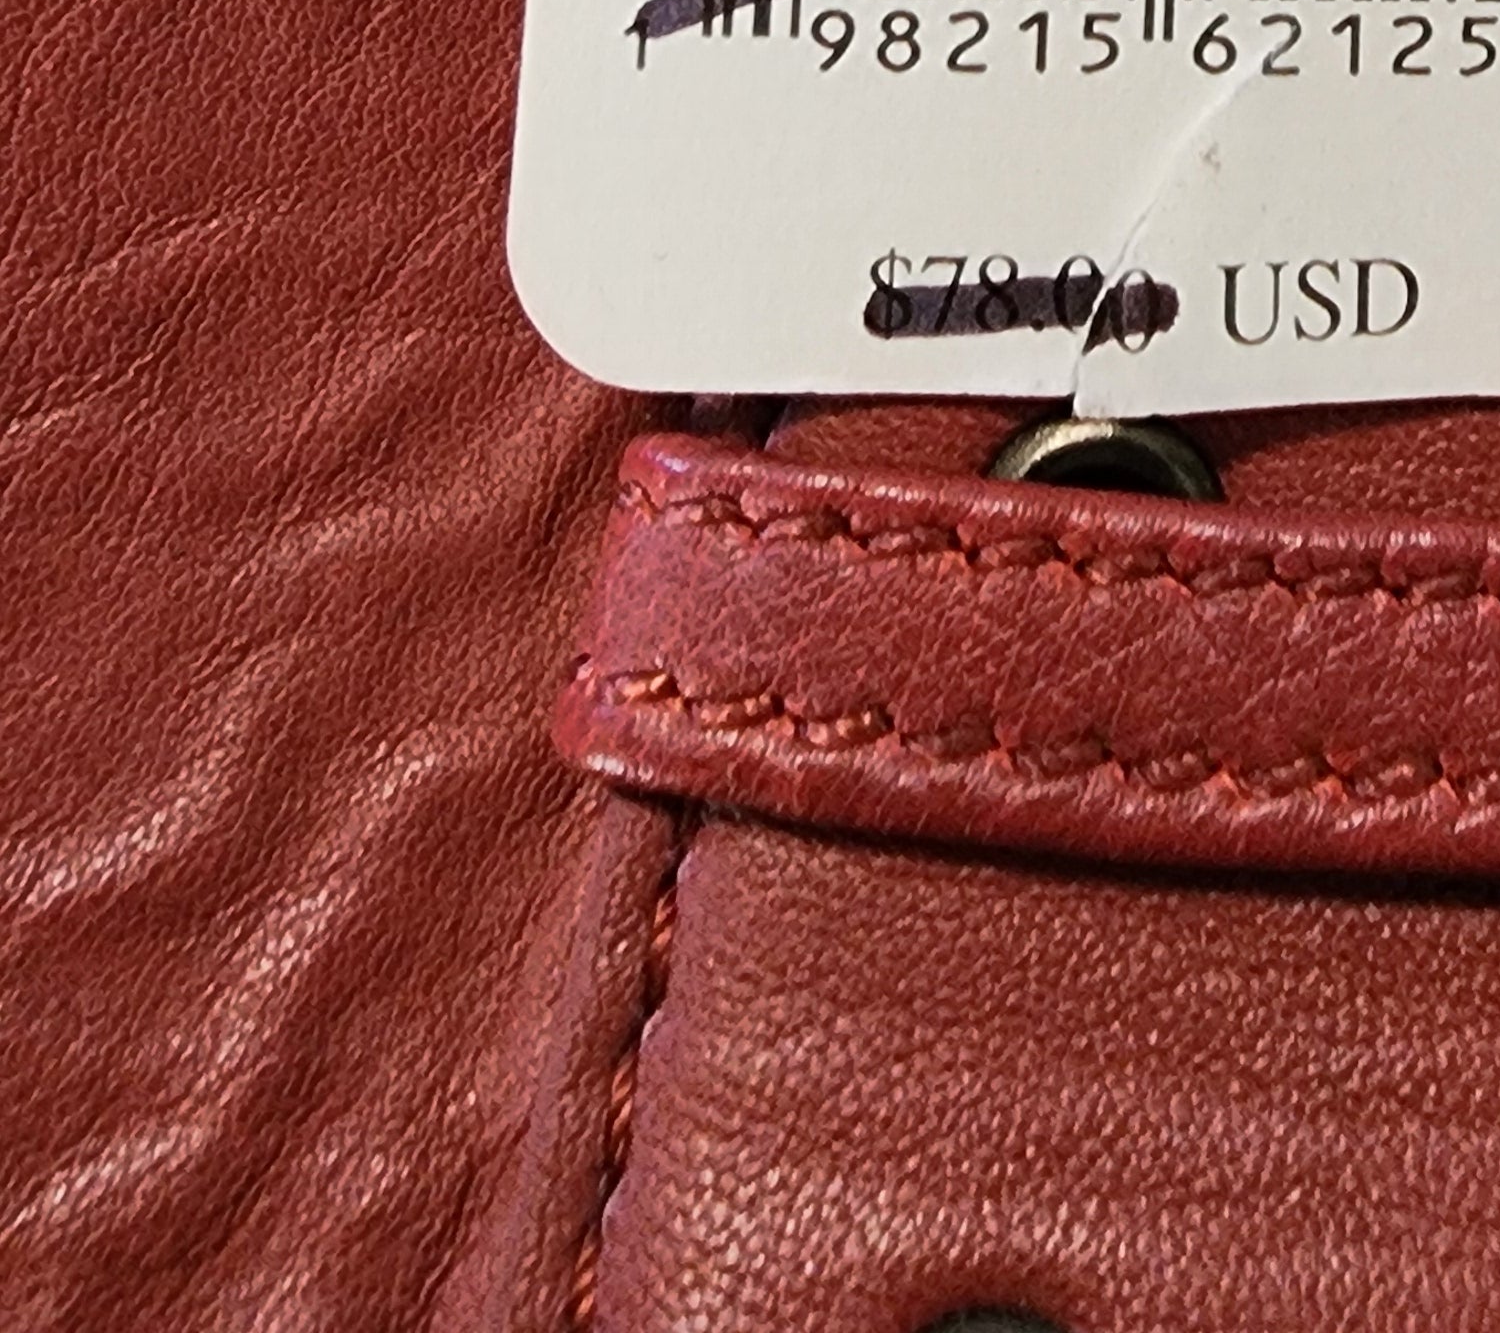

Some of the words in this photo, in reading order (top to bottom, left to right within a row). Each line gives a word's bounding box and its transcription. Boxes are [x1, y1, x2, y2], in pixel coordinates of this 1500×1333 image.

[809, 8, 1123, 75] 98215
[1191, 12, 1500, 78] 62125
[1218, 255, 1420, 347] USD
